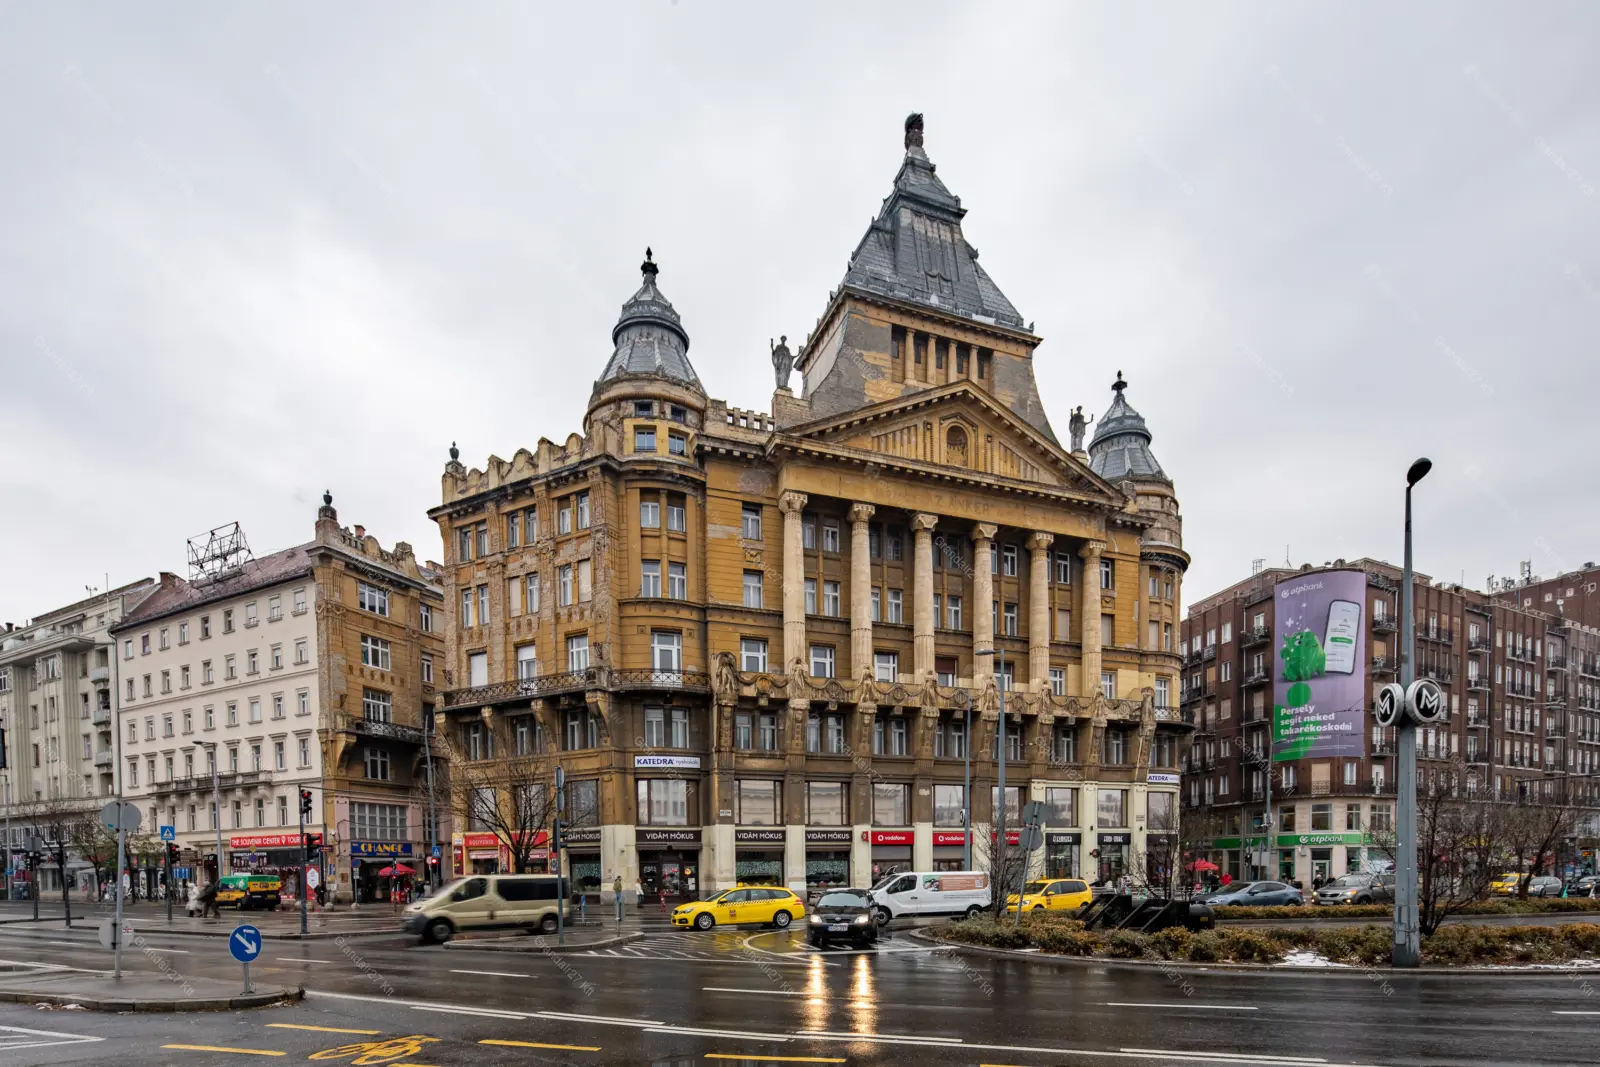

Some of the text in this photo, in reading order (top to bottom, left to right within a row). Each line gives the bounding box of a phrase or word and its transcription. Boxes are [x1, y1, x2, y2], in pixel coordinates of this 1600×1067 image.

[1290, 581, 1324, 594] otpbank
[1280, 704, 1315, 716] Persely
[1303, 712, 1335, 722] neked
[1280, 722, 1352, 736] takarékoskodni
[581, 832, 601, 840] MÓKUS
[645, 832, 695, 840] VIDÁM MÓKUS
[737, 831, 783, 840] VIDÁM MÓKUS
[806, 831, 850, 840] VIDÁM MÓKUS
[1310, 835, 1343, 844] otpbank
[240, 837, 262, 846] SOUVENIR
[262, 836, 281, 845] CENTER
[360, 843, 404, 853] CHANGE
